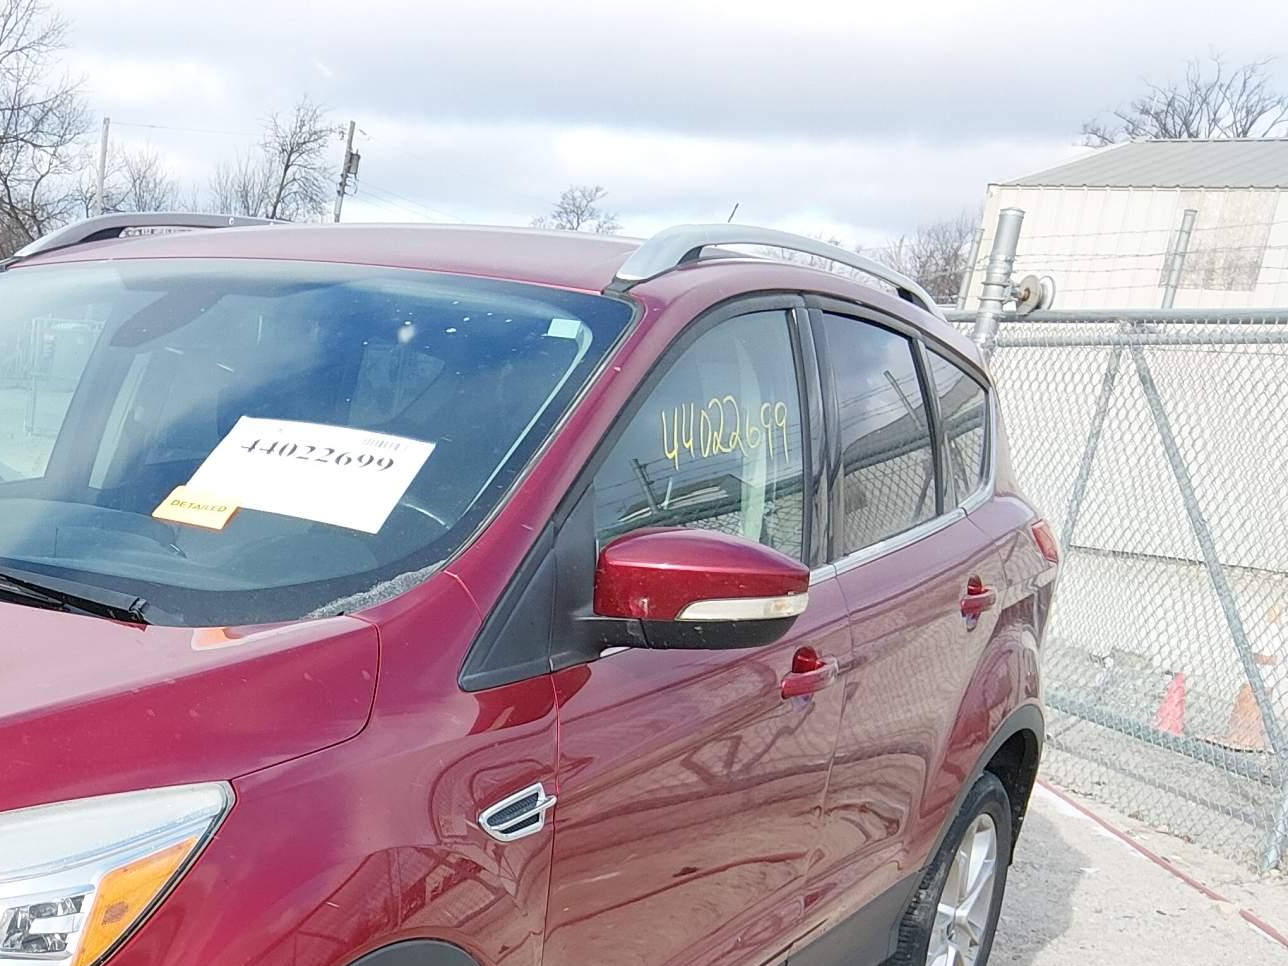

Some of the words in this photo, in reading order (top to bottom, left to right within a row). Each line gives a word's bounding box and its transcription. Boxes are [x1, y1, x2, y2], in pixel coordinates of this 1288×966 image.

[662, 395, 789, 471] 44022699
[240, 438, 394, 472] 44022699
[170, 499, 228, 513] DETAILED
